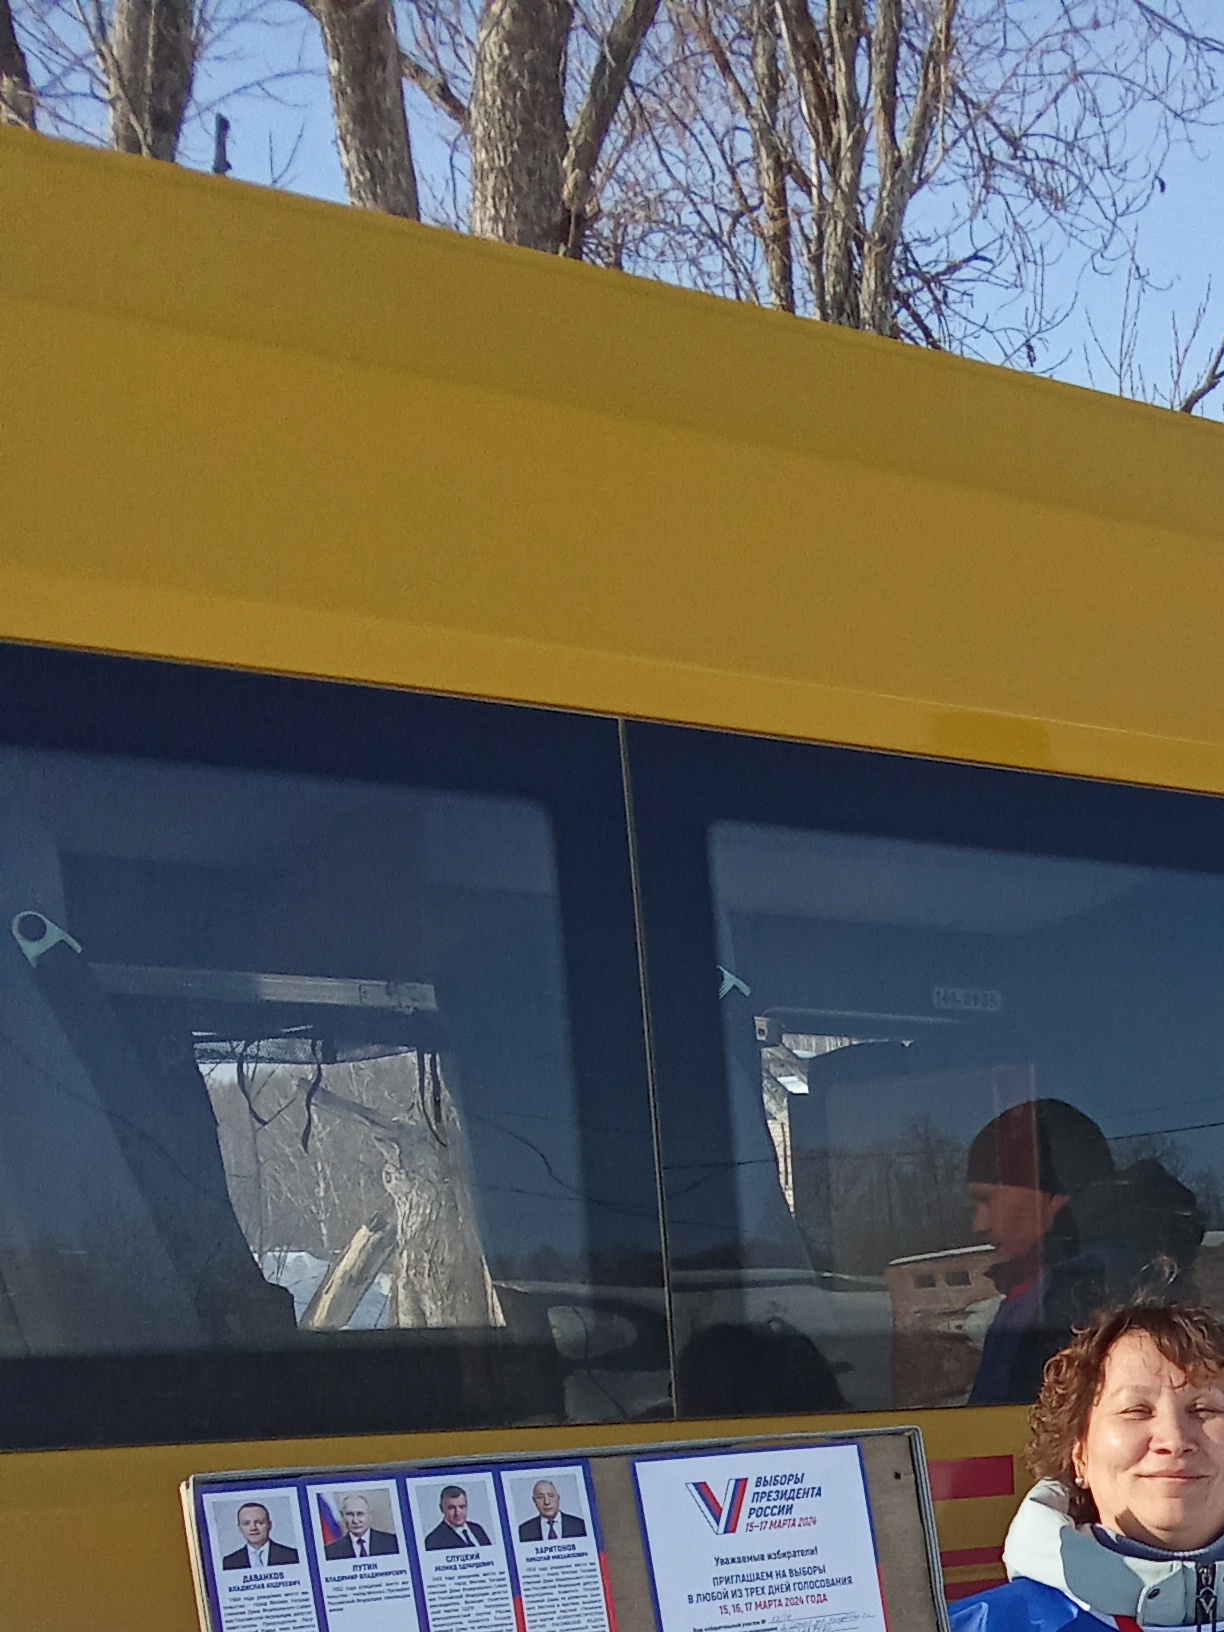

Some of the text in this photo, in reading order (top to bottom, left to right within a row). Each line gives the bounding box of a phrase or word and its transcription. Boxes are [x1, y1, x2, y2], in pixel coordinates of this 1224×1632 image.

[755, 1472, 805, 1487] ВЫБОРЫ
[751, 1486, 822, 1504] ПРЕЗИДЕНТА
[747, 1504, 793, 1519] РОССИИ
[769, 1518, 796, 1531] МАРТА
[798, 1515, 817, 1528] 2024
[714, 1546, 818, 1567] Уважаемые избиратели!
[712, 1565, 826, 1587] ПРИГЛАШАЕМ НА ВЫБОРЫ
[688, 1576, 853, 1604] В ЛЮБОЙ ИЗ ТРЕХ ДНЕЙ ГОЛОСОВАНИЯ
[719, 1593, 828, 1616] 15, 16, 17 МАРТА 2024 ГОДА
